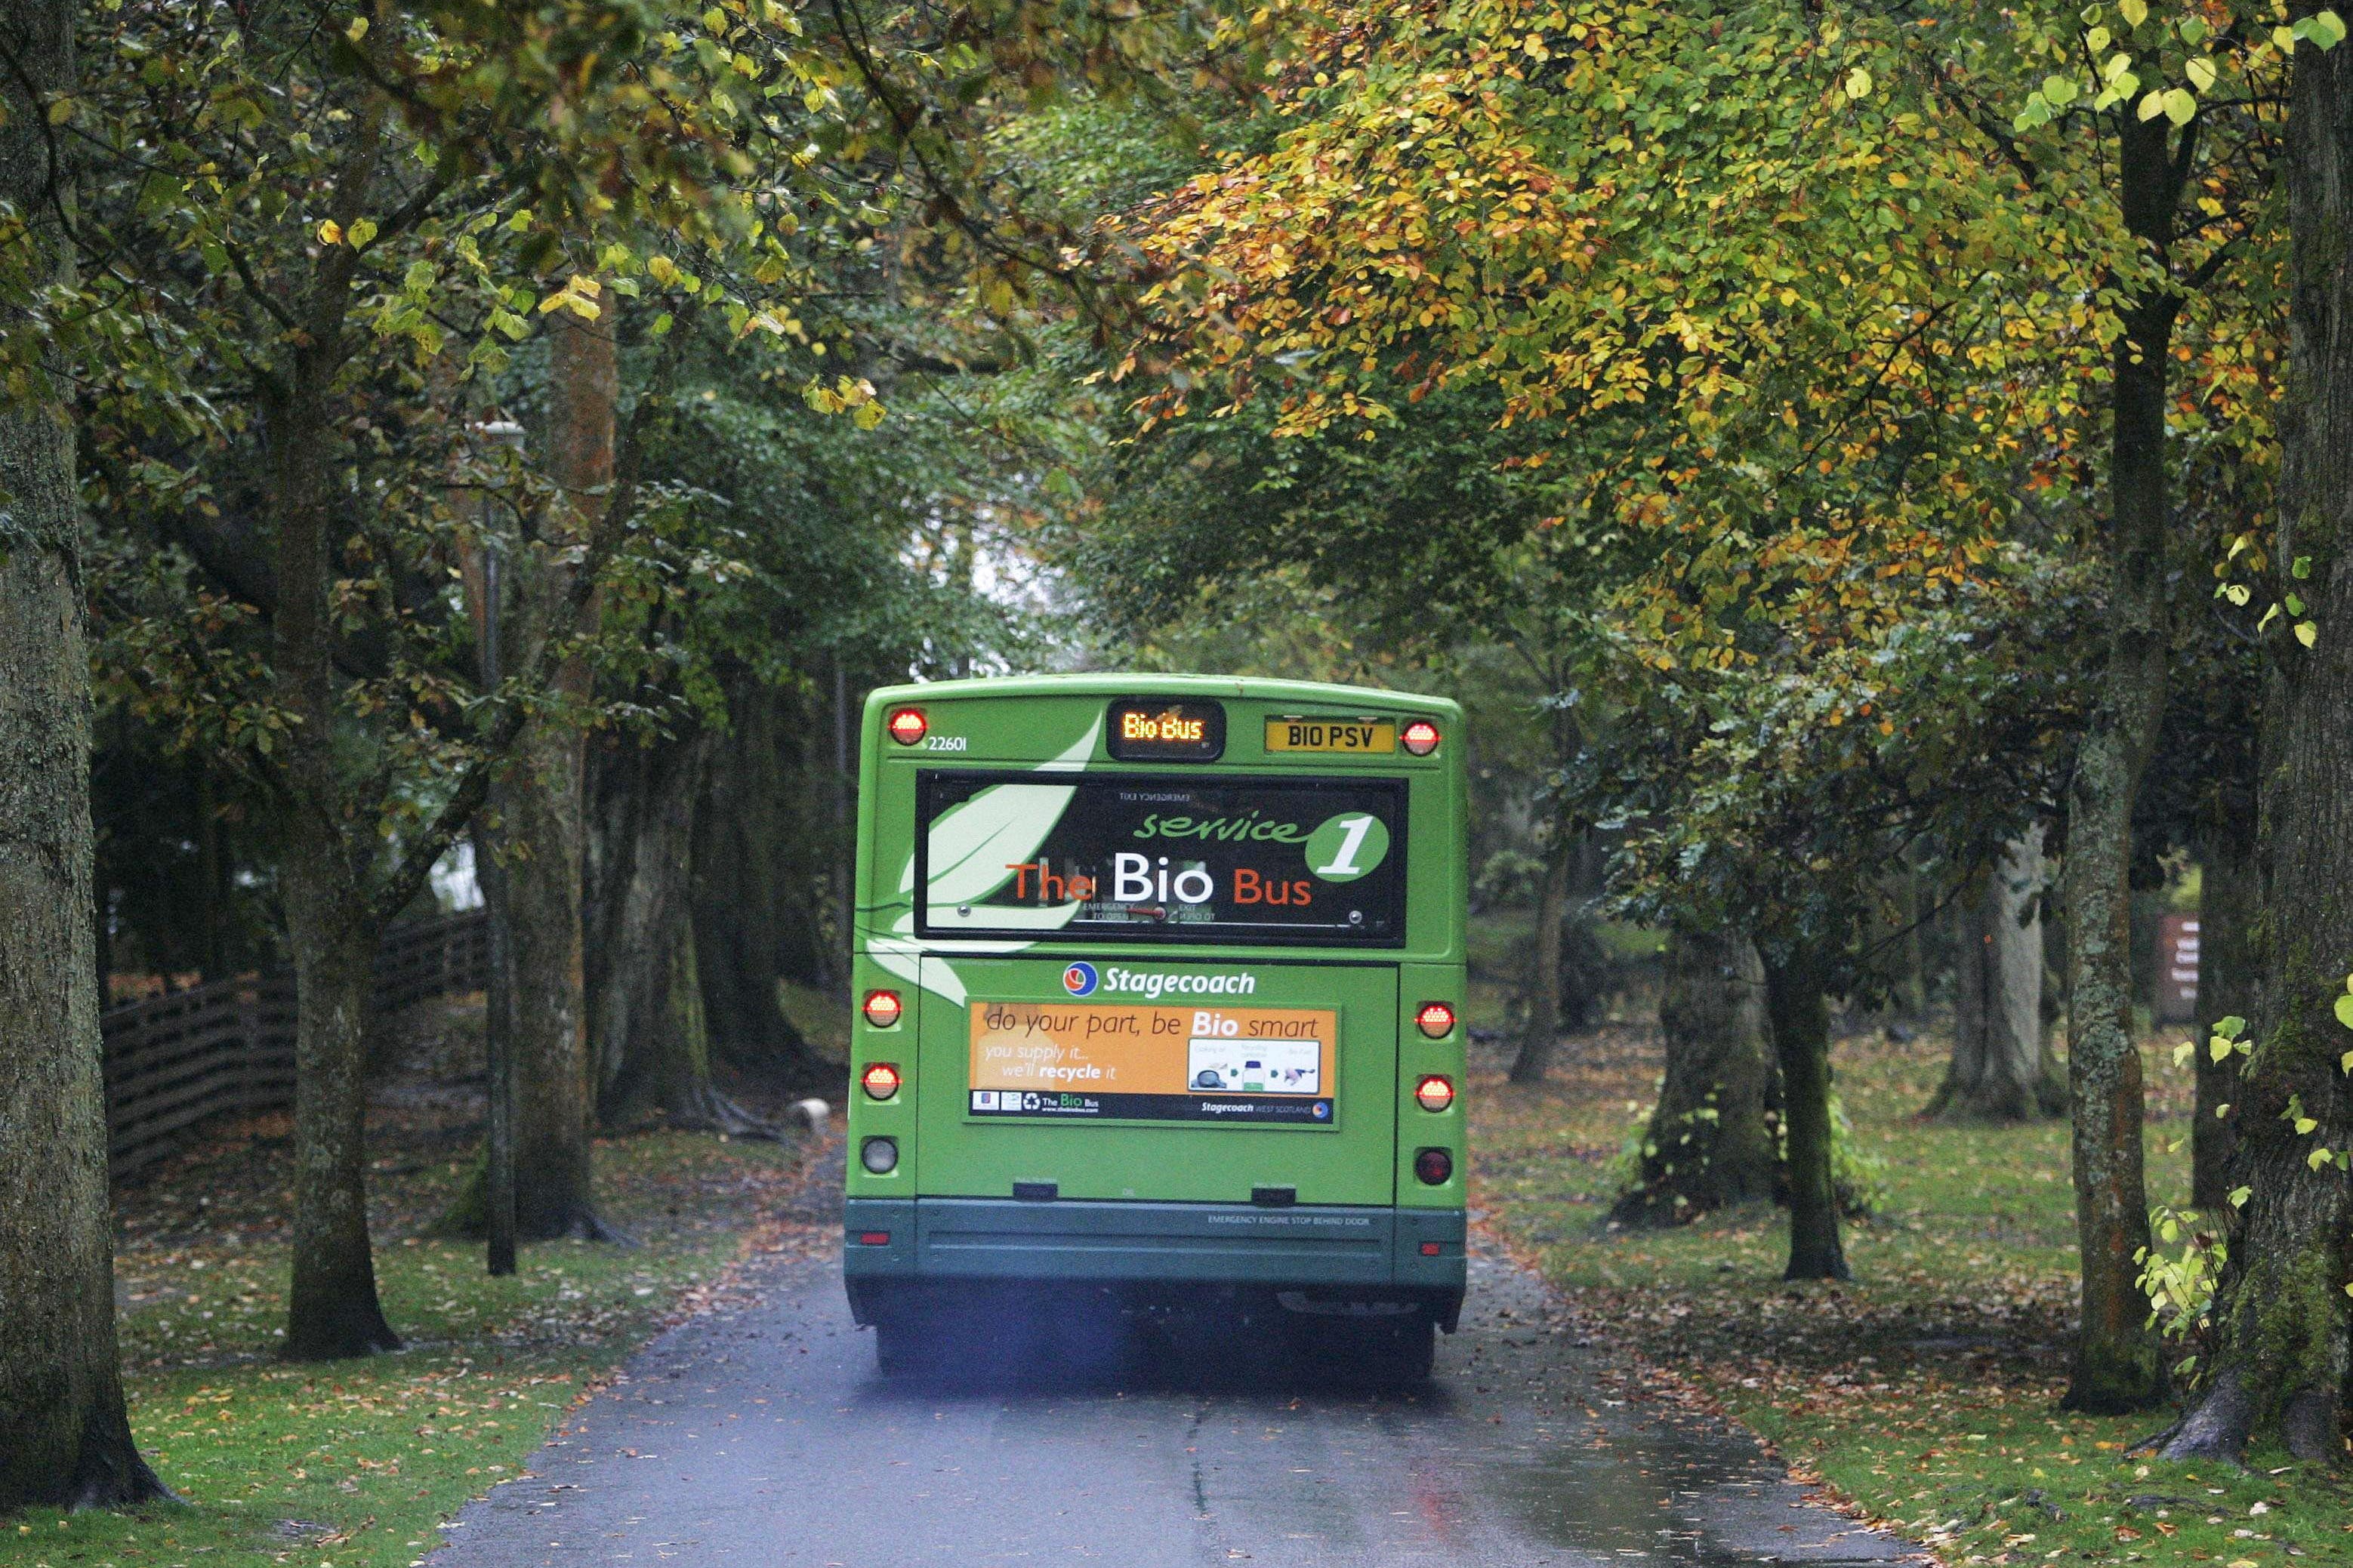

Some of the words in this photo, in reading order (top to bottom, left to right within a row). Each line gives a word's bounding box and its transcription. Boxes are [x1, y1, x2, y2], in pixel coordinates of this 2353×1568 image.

[1124, 713, 1158, 739] Bio
[1161, 713, 1203, 740] Bus
[1329, 726, 1374, 747] PSV
[929, 737, 967, 750] 22601
[1133, 810, 1312, 844] service
[1316, 815, 1374, 875] 1
[1005, 864, 1093, 901] The
[1114, 852, 1214, 904] Bio
[1233, 868, 1312, 906] Bus
[1103, 967, 1256, 1000] Stagecoach
[986, 1006, 1016, 1030] do
[1025, 1013, 1080, 1039] your
[1086, 1013, 1140, 1040] part,
[1152, 1011, 1181, 1035] be
[1191, 1011, 1238, 1037] Bio
[1248, 1018, 1319, 1038] smart
[985, 1046, 1012, 1061] you
[1017, 1044, 1065, 1062] supply
[1002, 1063, 1035, 1077] we'll
[1039, 1064, 1101, 1082] recycle
[1106, 1066, 1117, 1080] it
[1042, 1098, 1058, 1107] The
[1061, 1093, 1083, 1107] Bio
[1084, 1098, 1099, 1107] Bus
[1201, 1101, 1254, 1114] Stagecoach
[1208, 1215, 1257, 1224] EMERGENCY
[1259, 1215, 1290, 1225] ENGINE
[1291, 1216, 1311, 1225] STOP
[1313, 1217, 1343, 1225] BEHIND
